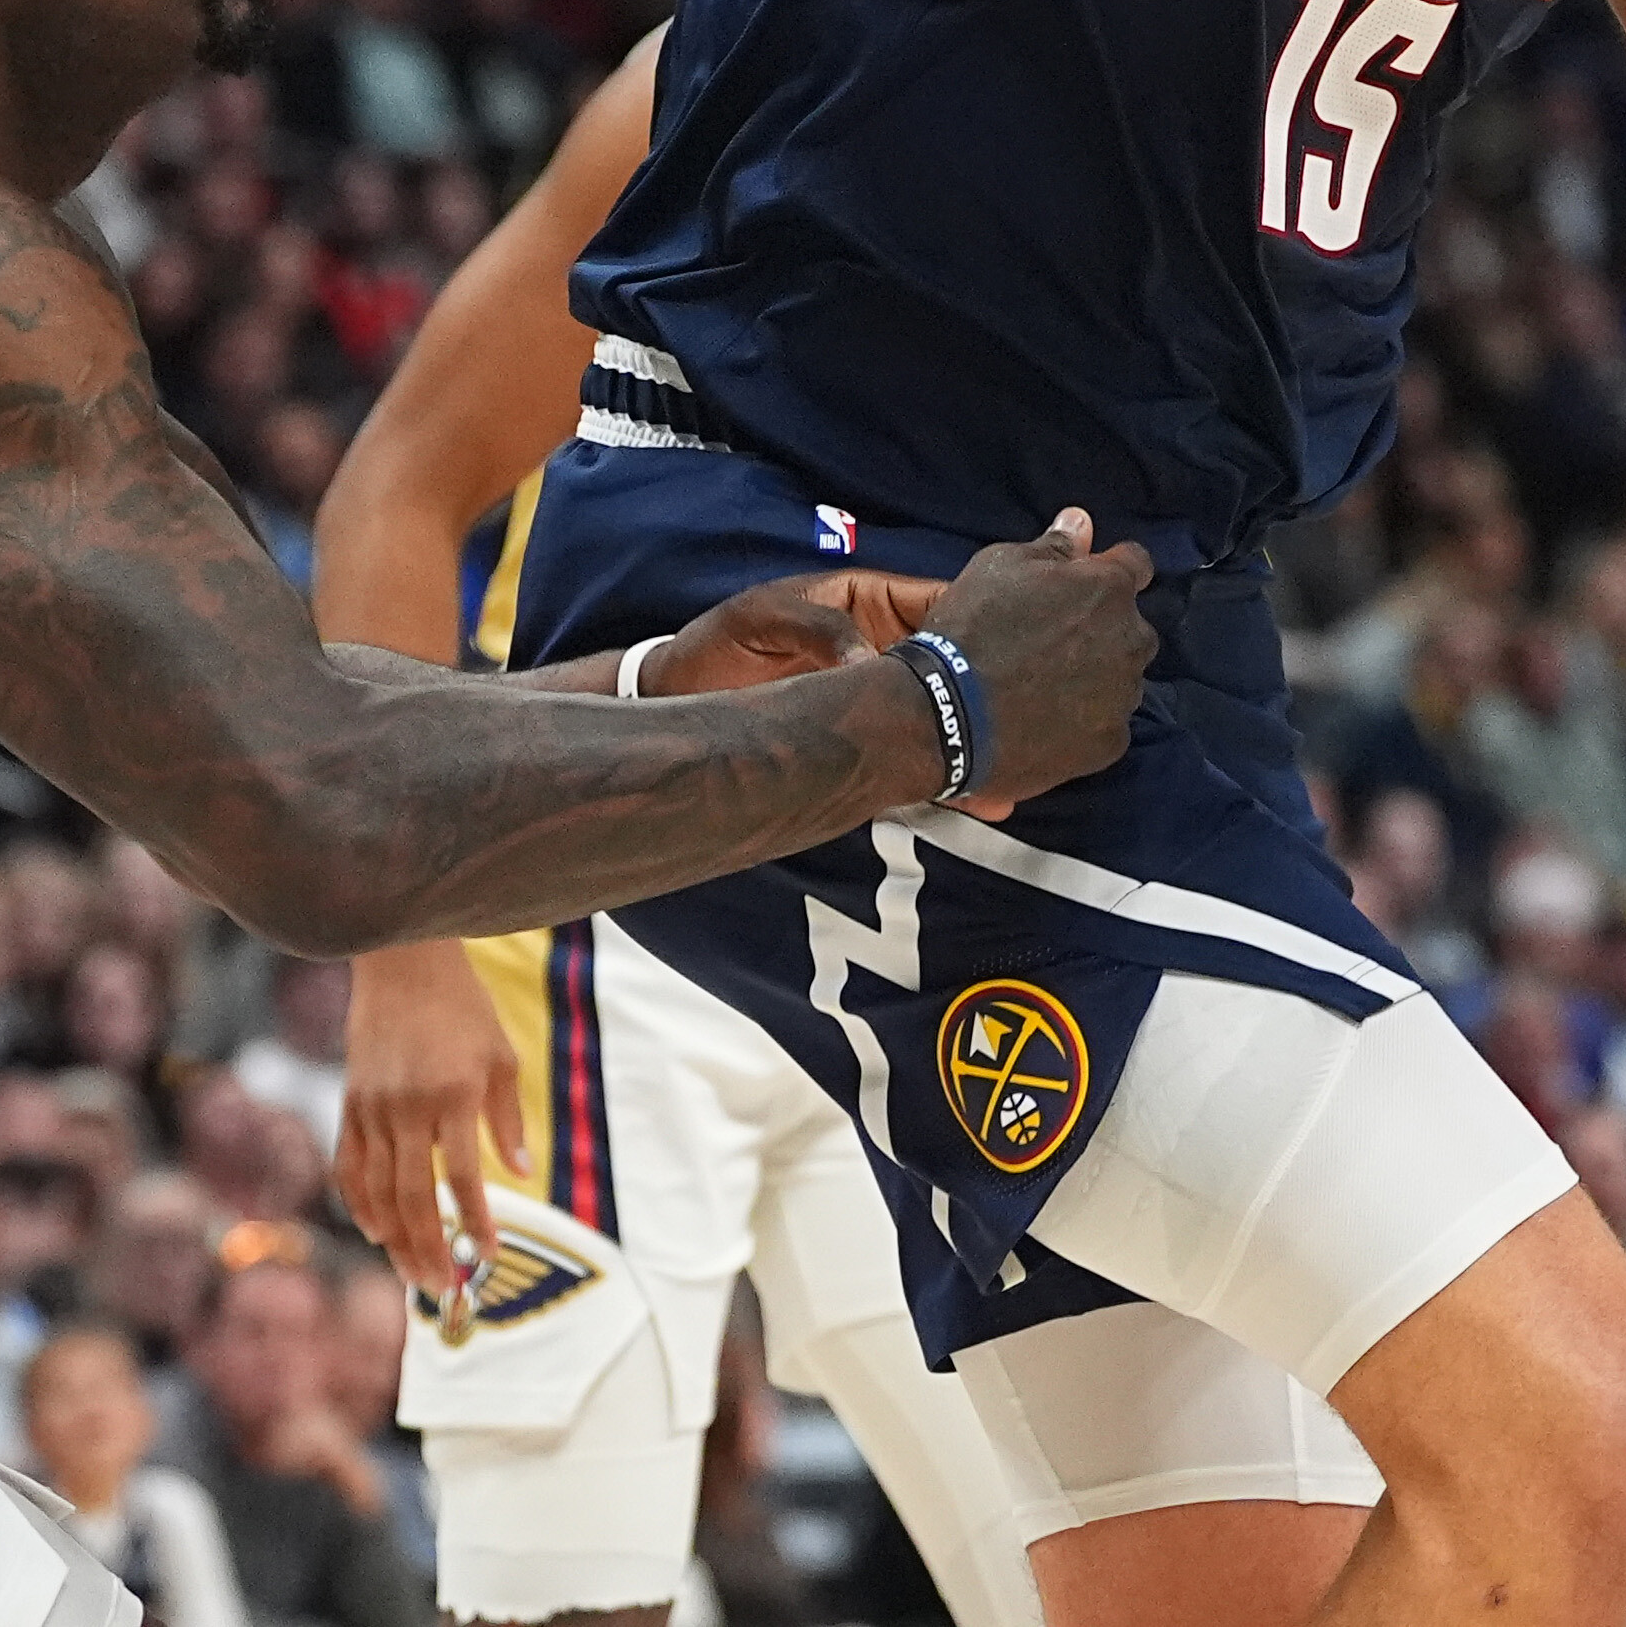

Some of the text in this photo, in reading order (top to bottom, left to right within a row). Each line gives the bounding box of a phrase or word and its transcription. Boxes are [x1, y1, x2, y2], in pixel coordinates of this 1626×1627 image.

[819, 533, 841, 550] NBA
[925, 671, 965, 784] READY TO
